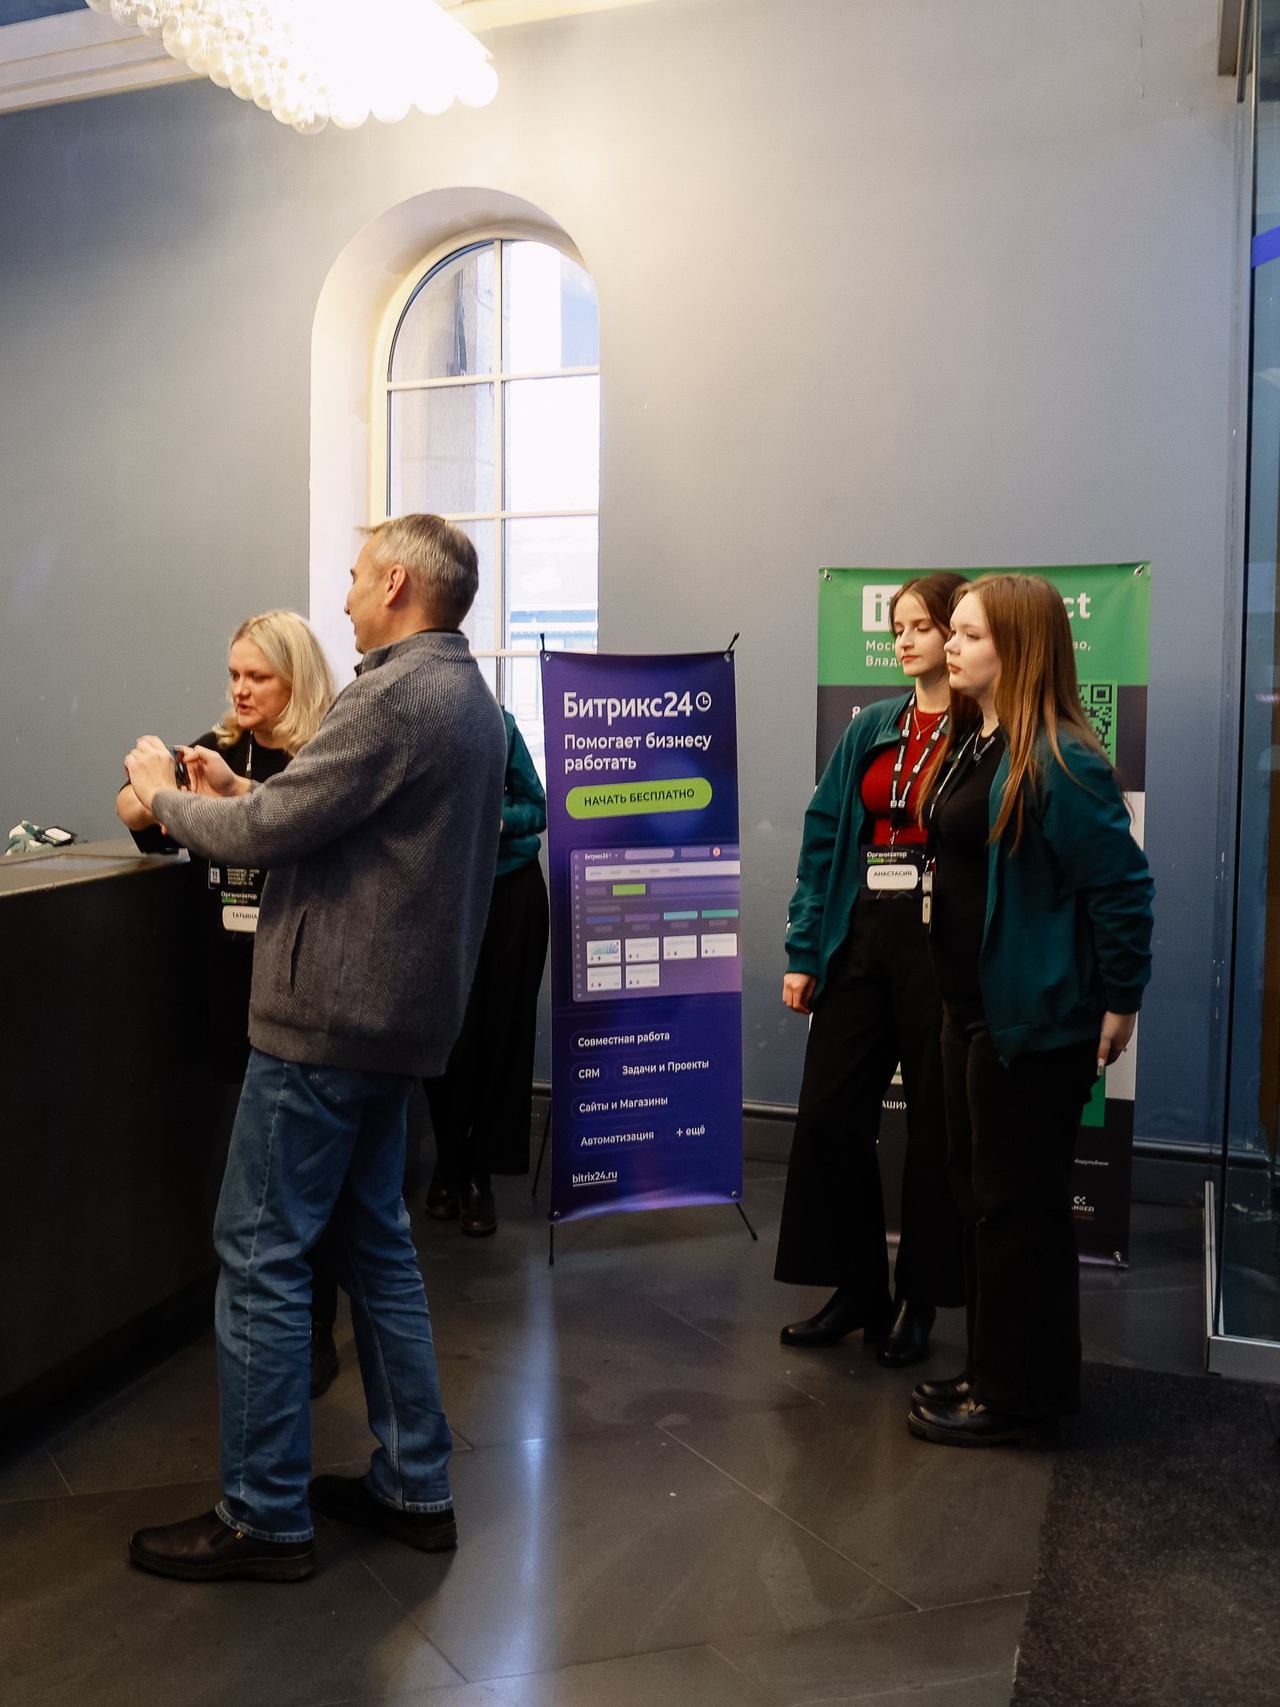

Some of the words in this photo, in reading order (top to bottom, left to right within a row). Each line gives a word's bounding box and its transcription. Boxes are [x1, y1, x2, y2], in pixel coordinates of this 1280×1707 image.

[563, 691, 693, 726] Битрикс24
[564, 733, 642, 750] Помогает
[645, 732, 712, 751] бизнесу
[564, 754, 637, 774] работать
[584, 794, 627, 807] НАЧАТЬ
[629, 788, 695, 803] БЕСПЛАТНО
[578, 1033, 635, 1048] Совместная
[637, 1031, 670, 1045] работа
[578, 1067, 600, 1079] CRM
[622, 1063, 657, 1077] Задачи
[659, 1063, 666, 1072] и
[667, 1059, 709, 1074] Проекты
[579, 1101, 609, 1113] Сайты
[611, 1101, 618, 1110] и
[620, 1095, 668, 1109] Магазины
[580, 1131, 655, 1147] Автоматизация
[686, 1124, 706, 1137] ещё
[572, 1170, 618, 1185] bitrix24.ru
